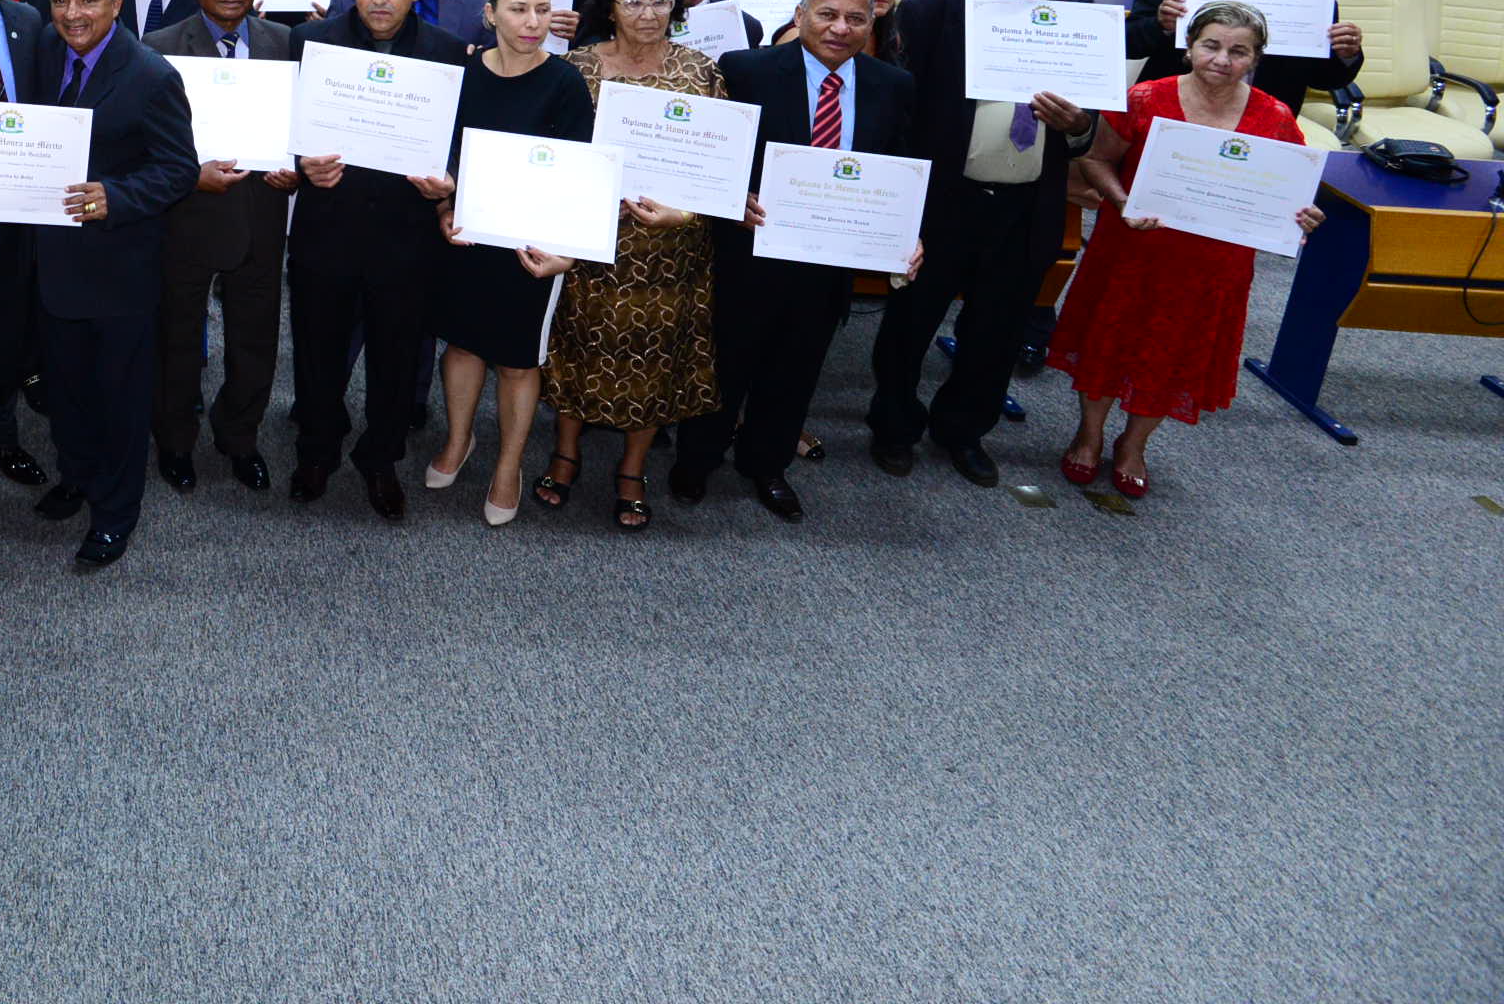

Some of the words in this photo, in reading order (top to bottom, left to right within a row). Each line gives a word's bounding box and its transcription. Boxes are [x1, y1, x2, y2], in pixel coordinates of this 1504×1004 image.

[992, 25, 1022, 35] Diploma
[1036, 29, 1059, 37] Honra
[1073, 32, 1098, 40] Mérito
[622, 117, 653, 129] Diploma
[666, 124, 690, 135] Honra
[703, 131, 728, 142] Mérito
[0, 137, 23, 147] Honra
[37, 141, 64, 150] Mérito
